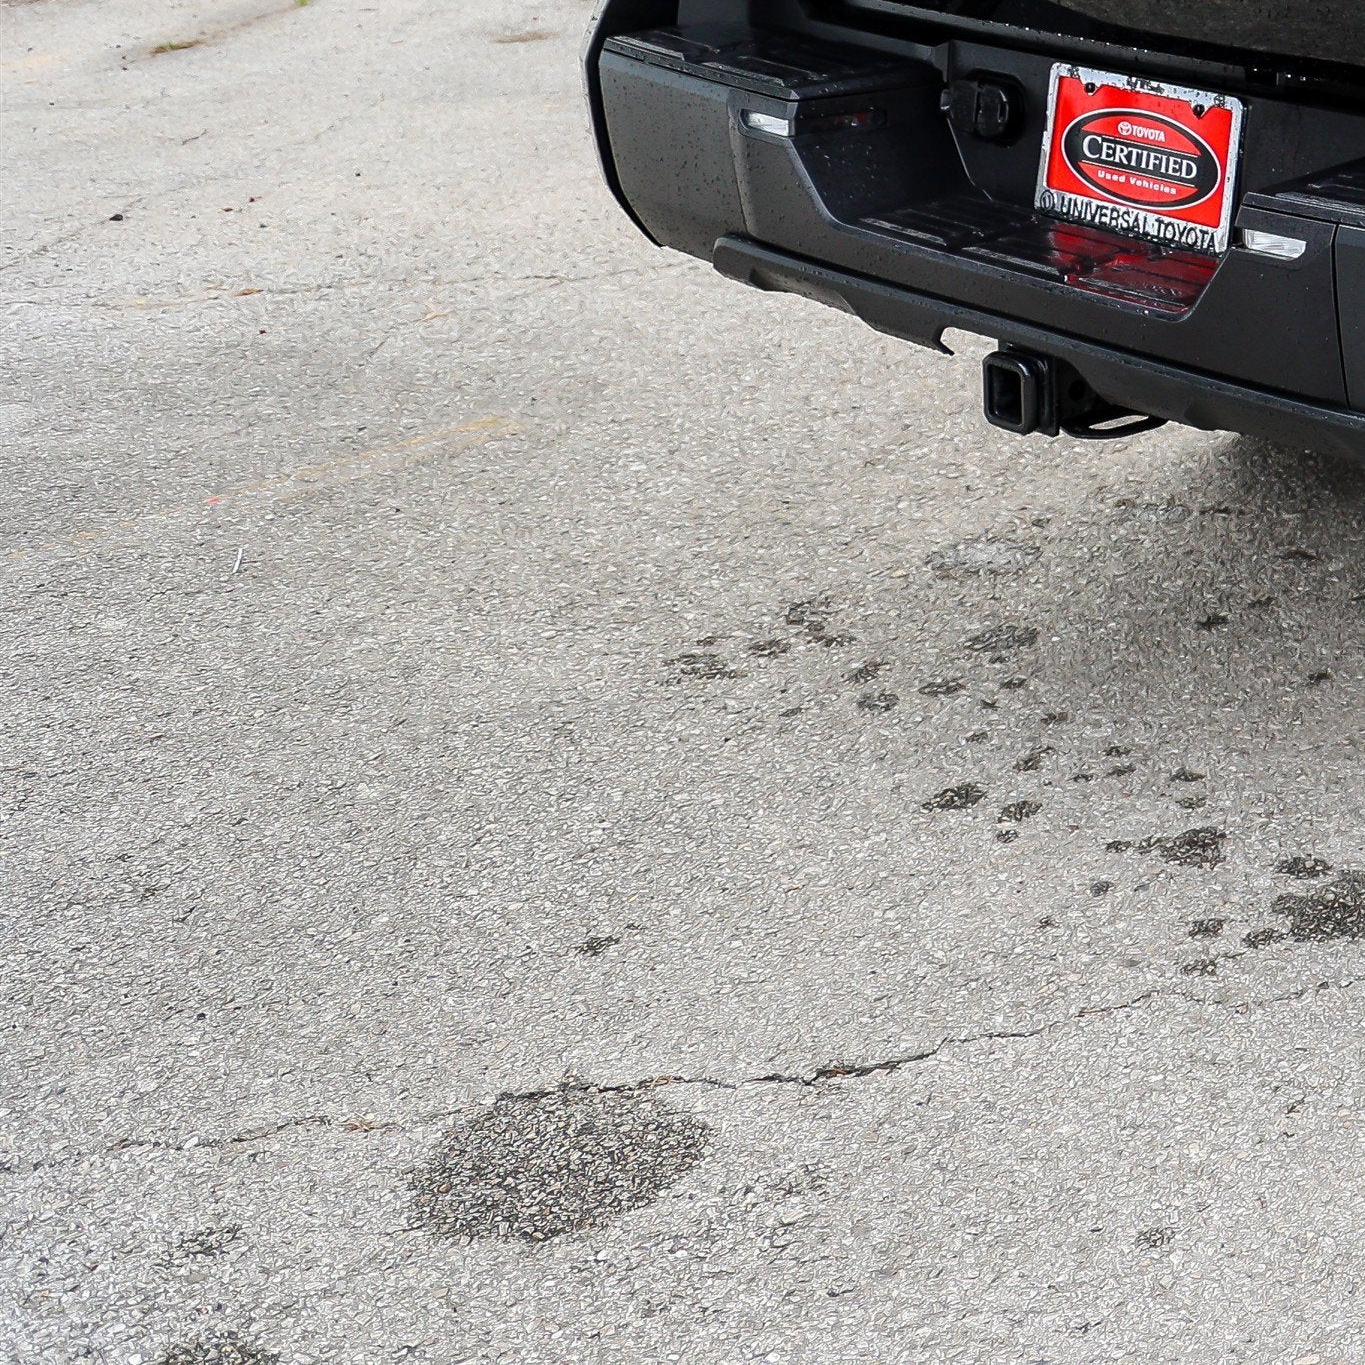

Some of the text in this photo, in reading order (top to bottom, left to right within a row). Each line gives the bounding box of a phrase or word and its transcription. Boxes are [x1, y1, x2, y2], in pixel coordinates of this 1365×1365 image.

[1131, 126, 1166, 142] TOYOTA
[1097, 170, 1177, 195] Used Vehicles
[1060, 196, 1150, 235] UNIVERSAL
[1154, 218, 1217, 250] TOYOTA
